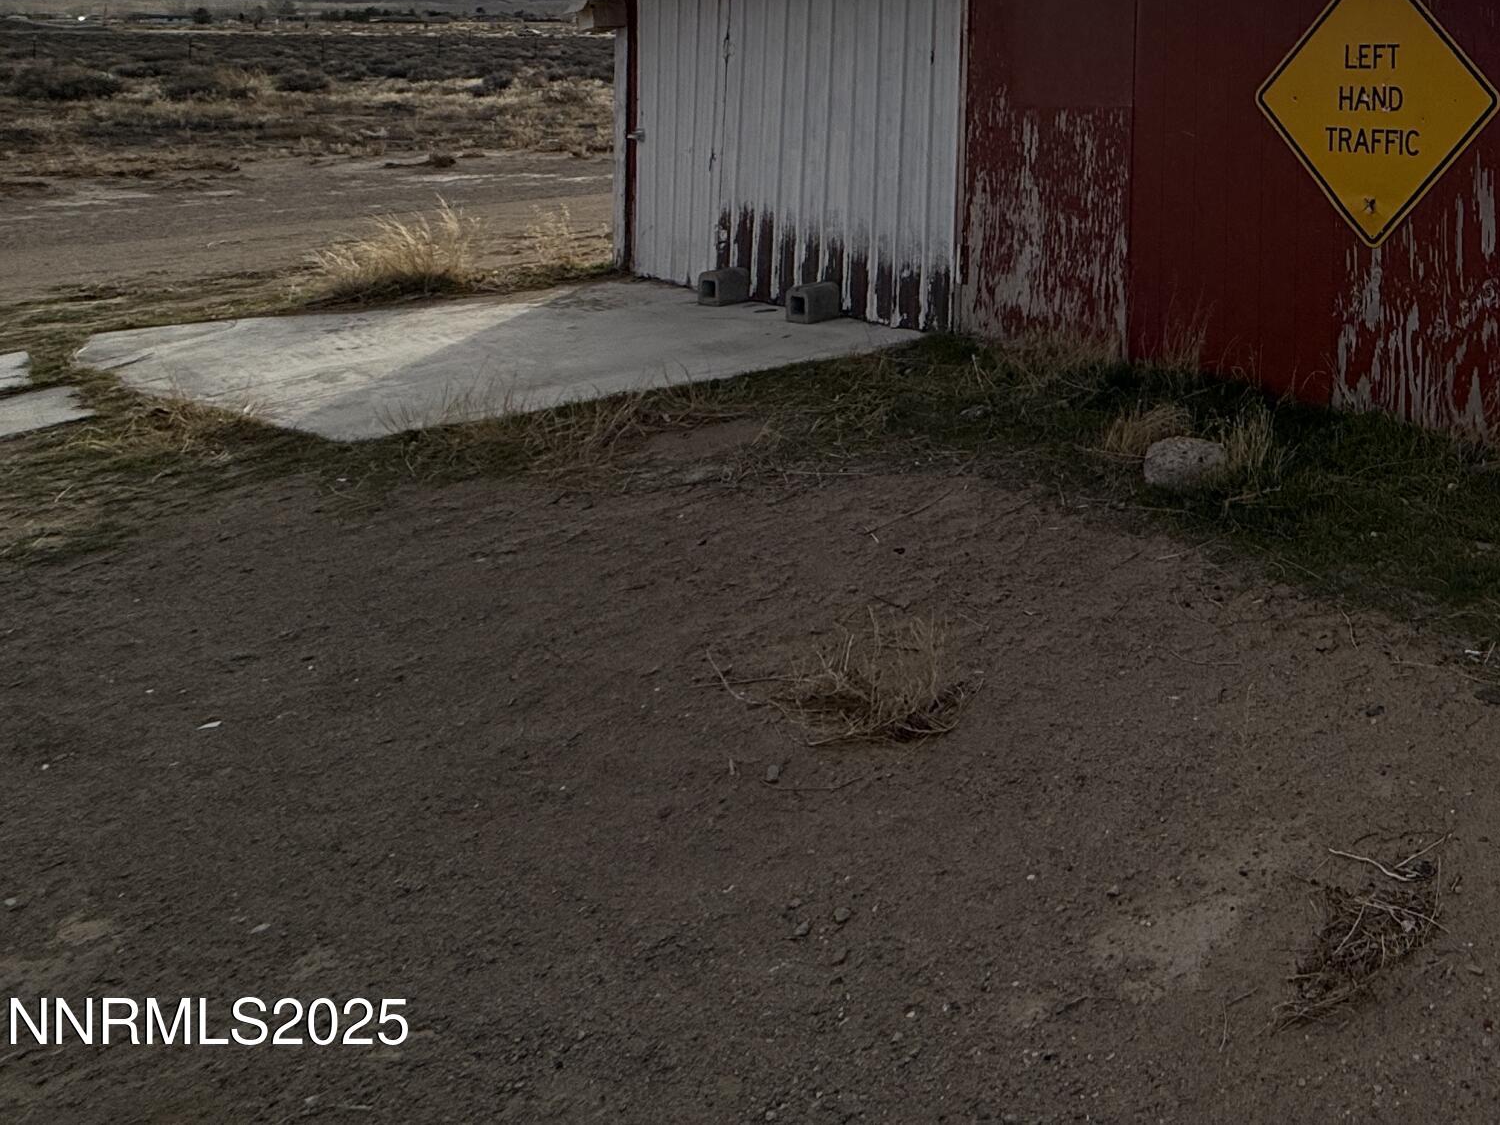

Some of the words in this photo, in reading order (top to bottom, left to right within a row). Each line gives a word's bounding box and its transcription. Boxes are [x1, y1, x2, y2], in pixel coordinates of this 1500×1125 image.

[1345, 44, 1400, 69] LEFT
[1339, 86, 1403, 111] HAND
[1325, 127, 1420, 156] TRAFFIC
